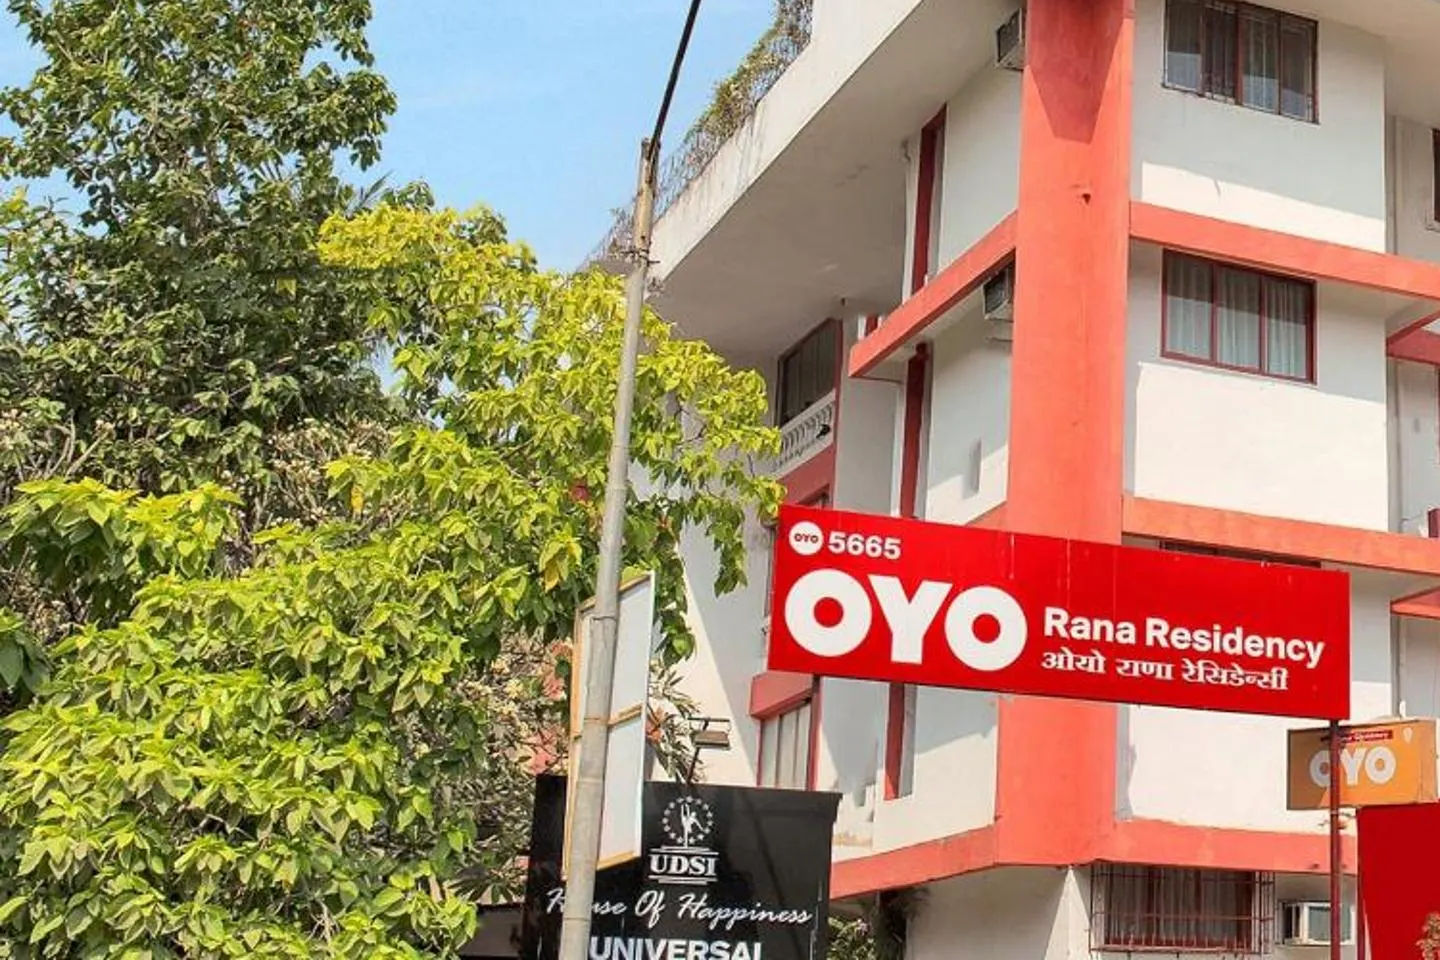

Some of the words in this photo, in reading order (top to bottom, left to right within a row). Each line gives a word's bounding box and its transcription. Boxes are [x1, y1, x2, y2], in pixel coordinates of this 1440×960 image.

[828, 530, 901, 560] 5665
[784, 568, 1028, 672] OYO
[1043, 606, 1136, 645] Rana
[1145, 617, 1325, 668] Residency
[1041, 646, 1106, 674] ओयो
[1115, 658, 1176, 681] राणा
[1182, 658, 1289, 690] रेसिडेन्सी
[1309, 746, 1396, 788] OYO
[649, 854, 719, 876] UDSI
[634, 890, 666, 929] Of
[677, 892, 812, 930] Happiness
